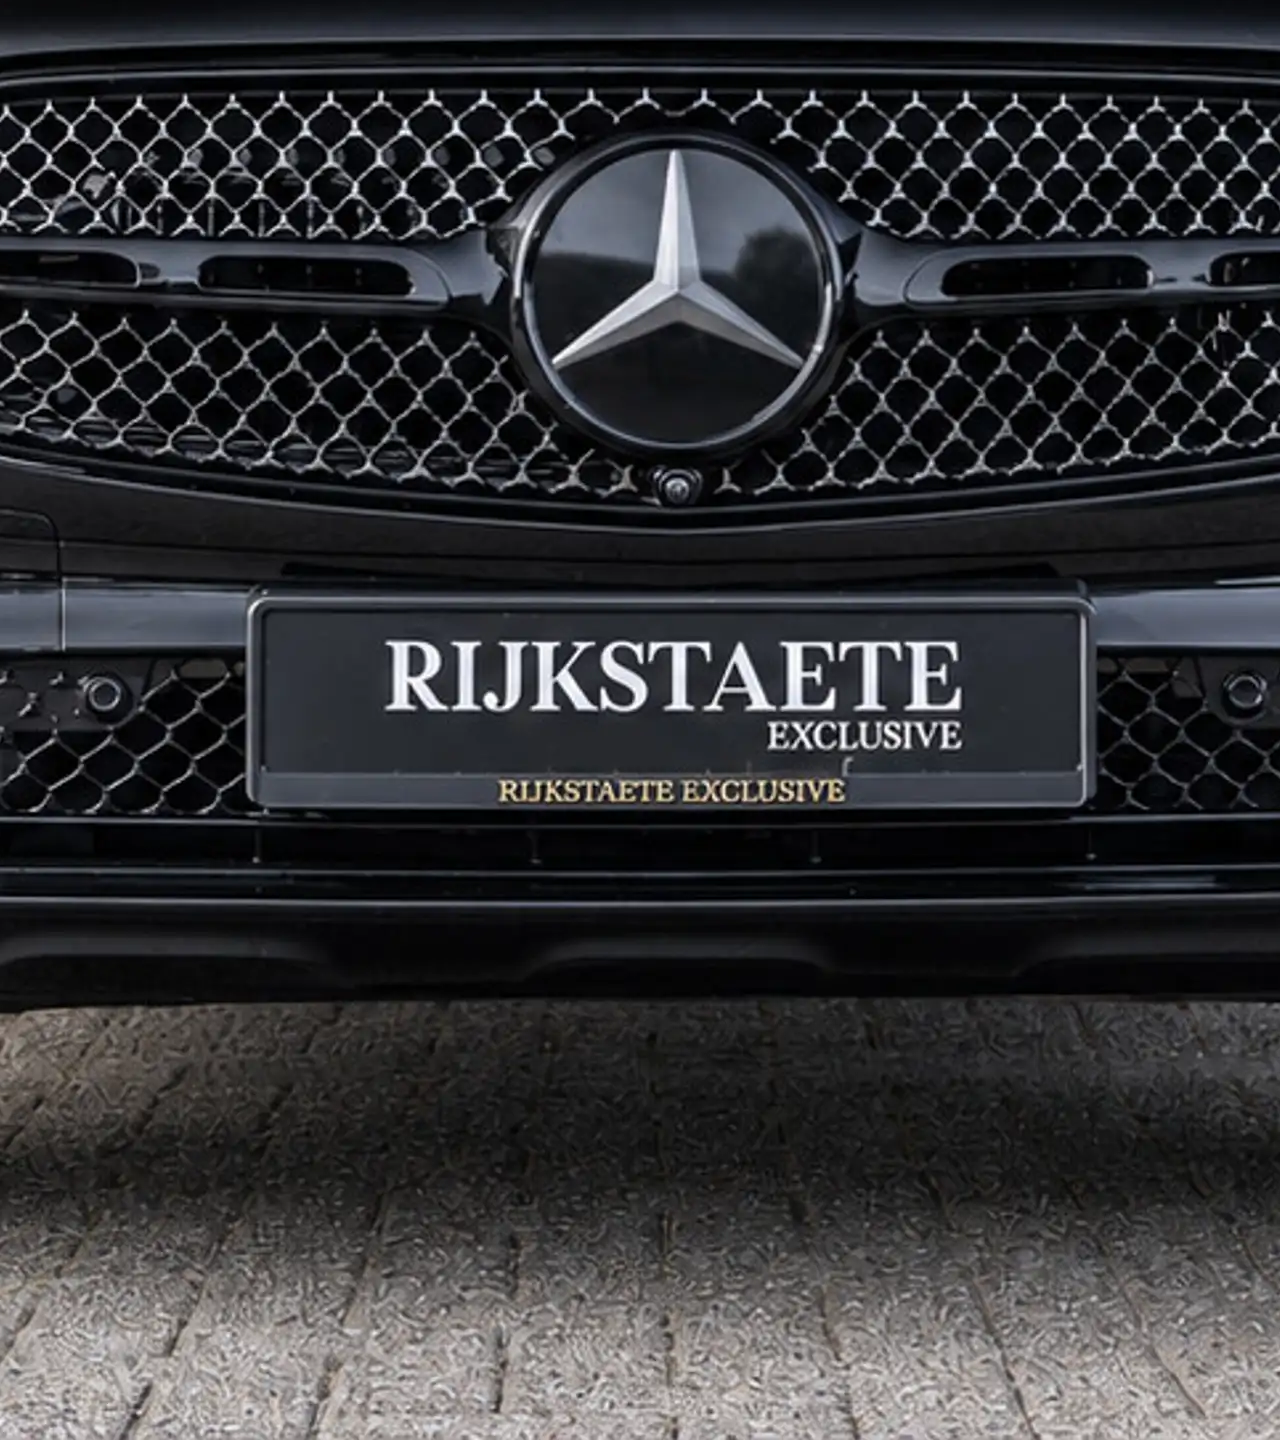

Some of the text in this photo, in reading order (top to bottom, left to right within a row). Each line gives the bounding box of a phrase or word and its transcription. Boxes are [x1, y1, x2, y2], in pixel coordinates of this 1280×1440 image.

[384, 639, 963, 713] RIJKSTAETE
[766, 720, 963, 751] EXCLUSIVE
[497, 779, 847, 803] RIJKSTAETE EXCLUSIVE
